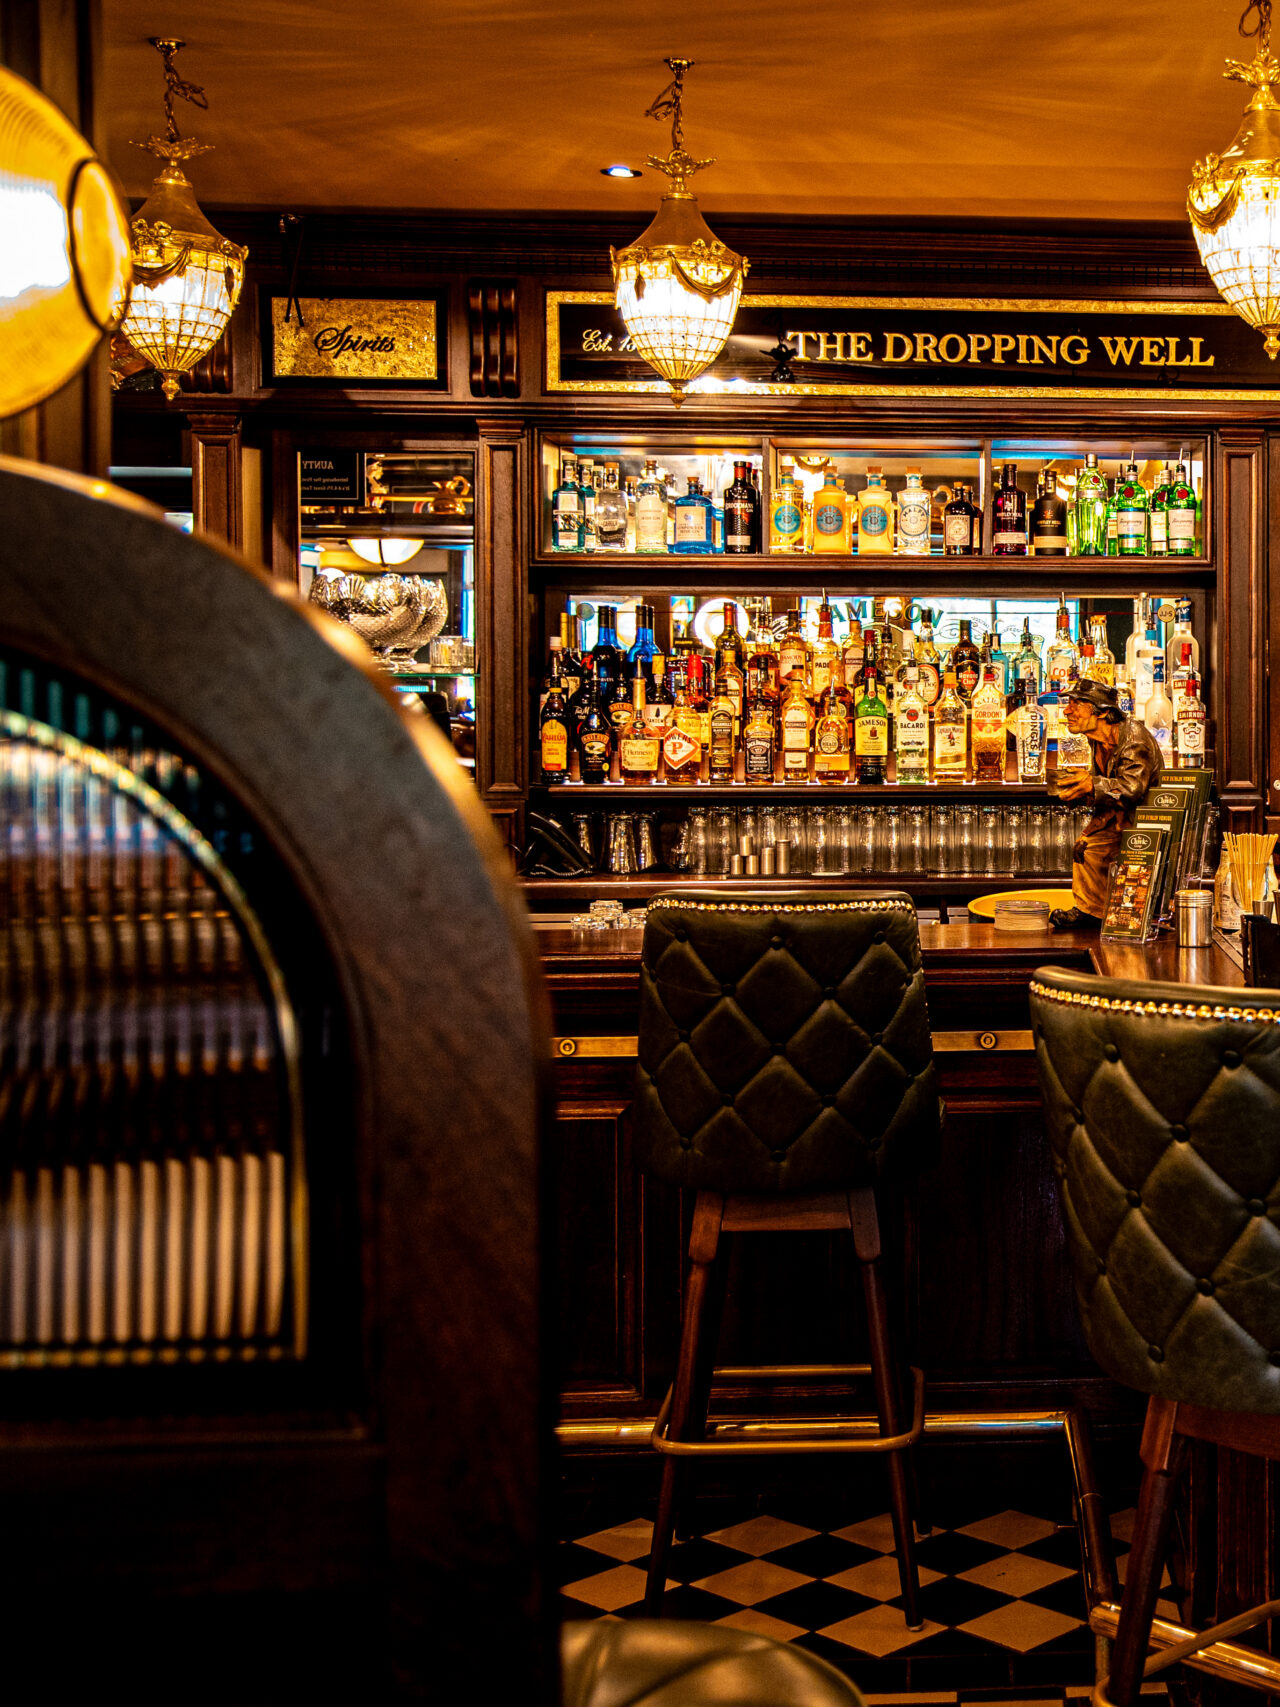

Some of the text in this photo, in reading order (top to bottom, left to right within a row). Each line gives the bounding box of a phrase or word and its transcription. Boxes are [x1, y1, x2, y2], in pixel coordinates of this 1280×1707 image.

[313, 324, 396, 359] Spirits
[582, 328, 613, 352] Est.
[787, 331, 1216, 367] THE DROPPING WELL
[903, 507, 926, 518] MALFY
[857, 719, 886, 729] JAMESON
[671, 742, 684, 755] P
